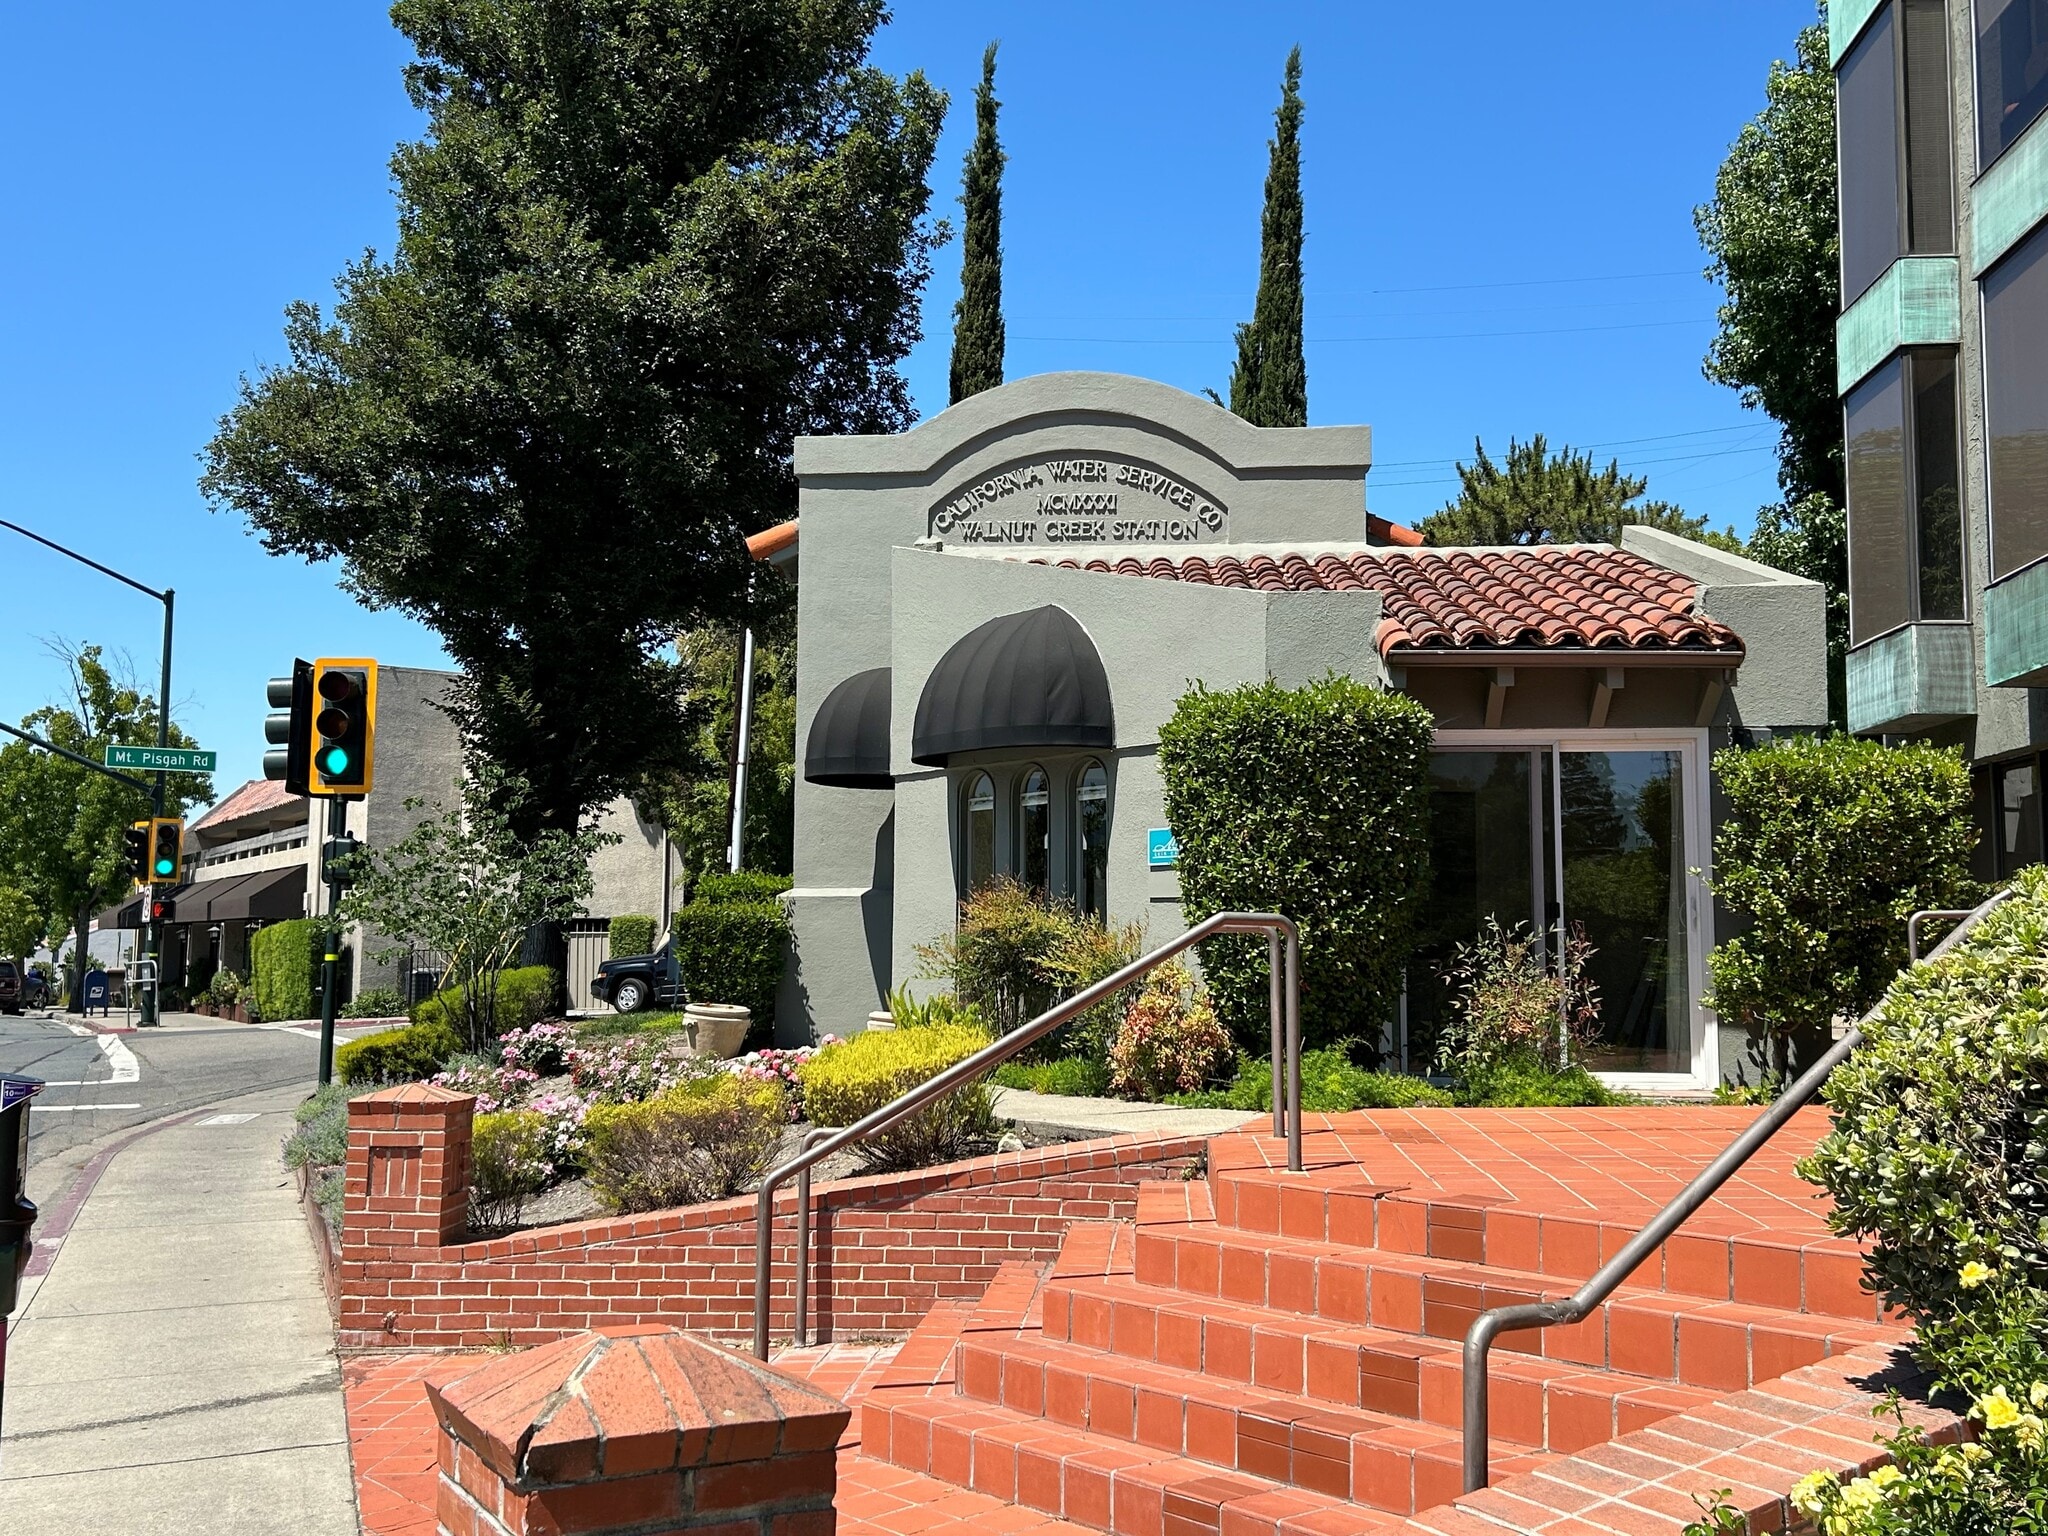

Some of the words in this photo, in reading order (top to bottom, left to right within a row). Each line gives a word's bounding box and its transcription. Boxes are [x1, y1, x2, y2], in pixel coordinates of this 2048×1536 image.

[935, 466, 1041, 531] CALIFORNIA
[1045, 460, 1107, 481] WATER
[1116, 465, 1195, 509] SERVICE
[1037, 493, 1117, 514] MCMXXXI
[956, 520, 1037, 541] WALNUT
[1045, 520, 1105, 541] CREEK
[1112, 519, 1199, 540] STATION
[115, 751, 135, 763] Mt.
[142, 752, 185, 767] Pisgah
[193, 755, 209, 766] Rd
